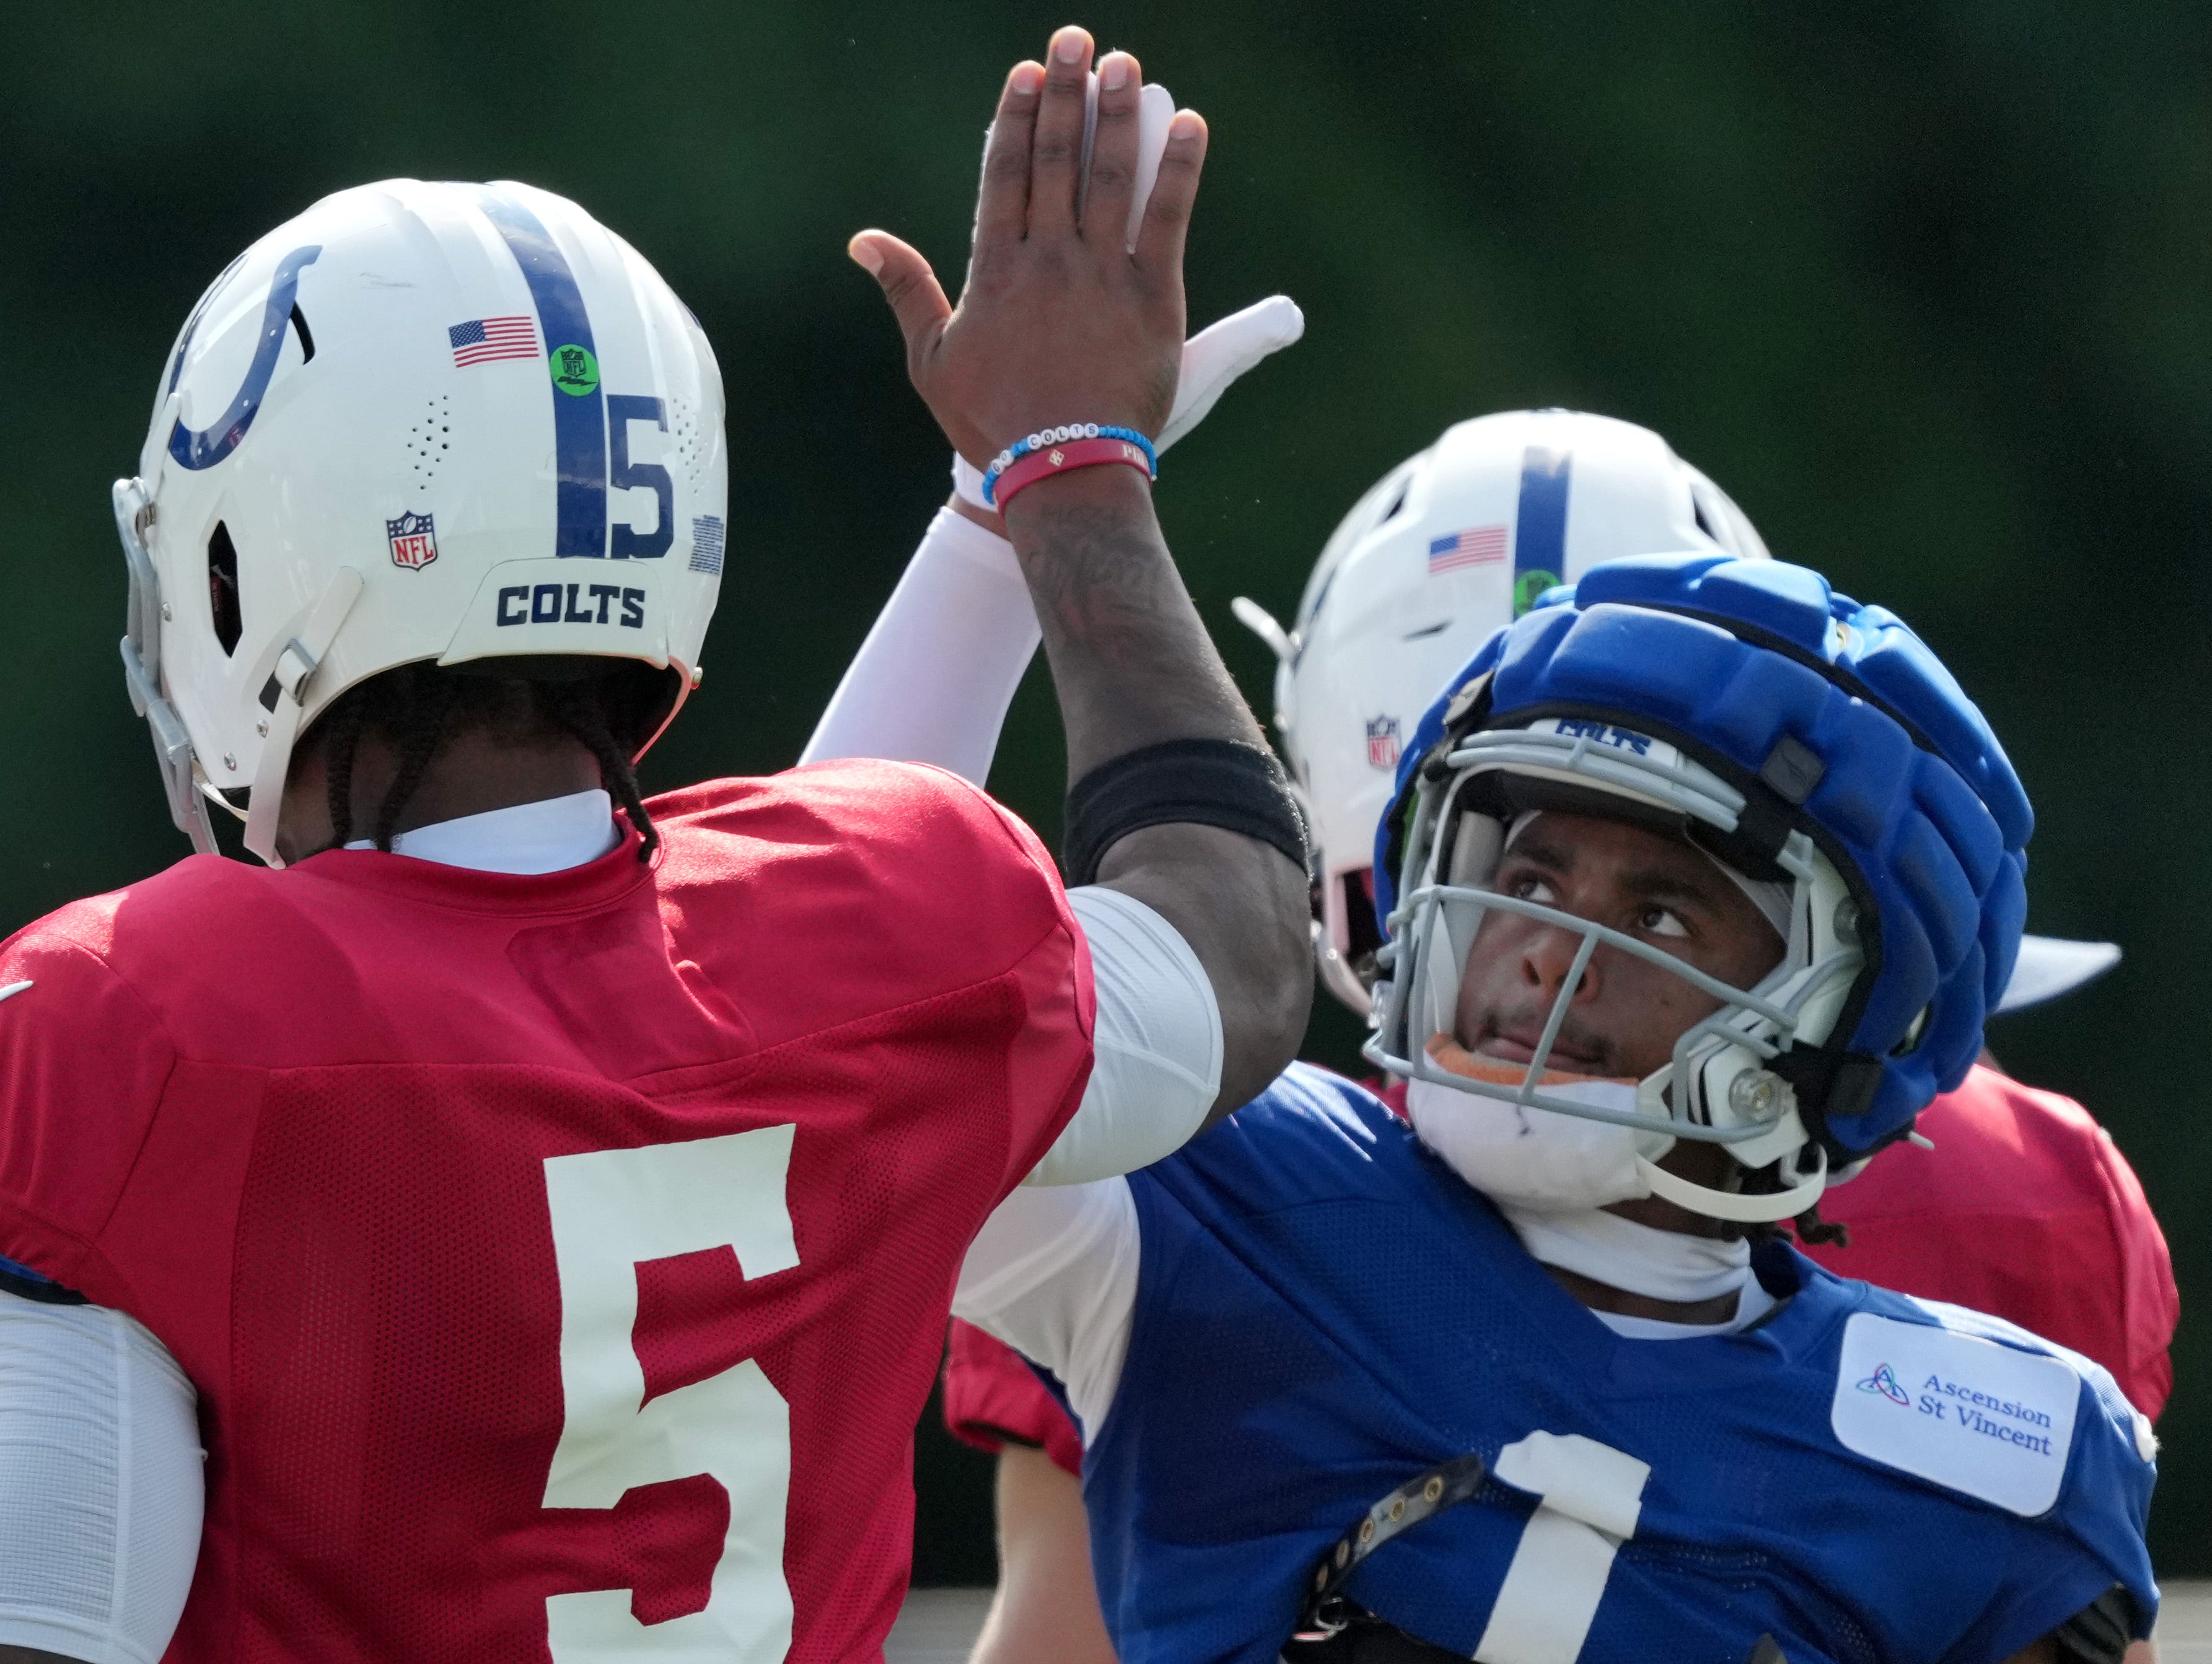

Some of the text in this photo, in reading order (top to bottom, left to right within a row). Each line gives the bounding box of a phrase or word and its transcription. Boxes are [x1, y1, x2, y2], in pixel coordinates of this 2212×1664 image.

[1030, 426, 1097, 446] COLTS
[607, 394, 674, 559] 5
[393, 536, 434, 564] NFL
[497, 584, 646, 629] COLTS
[541, 1123, 801, 1664] 5
[1923, 1375, 2051, 1428] Ascension
[1918, 1395, 2052, 1456] St Vincent
[1473, 1429, 1651, 1664] 1
